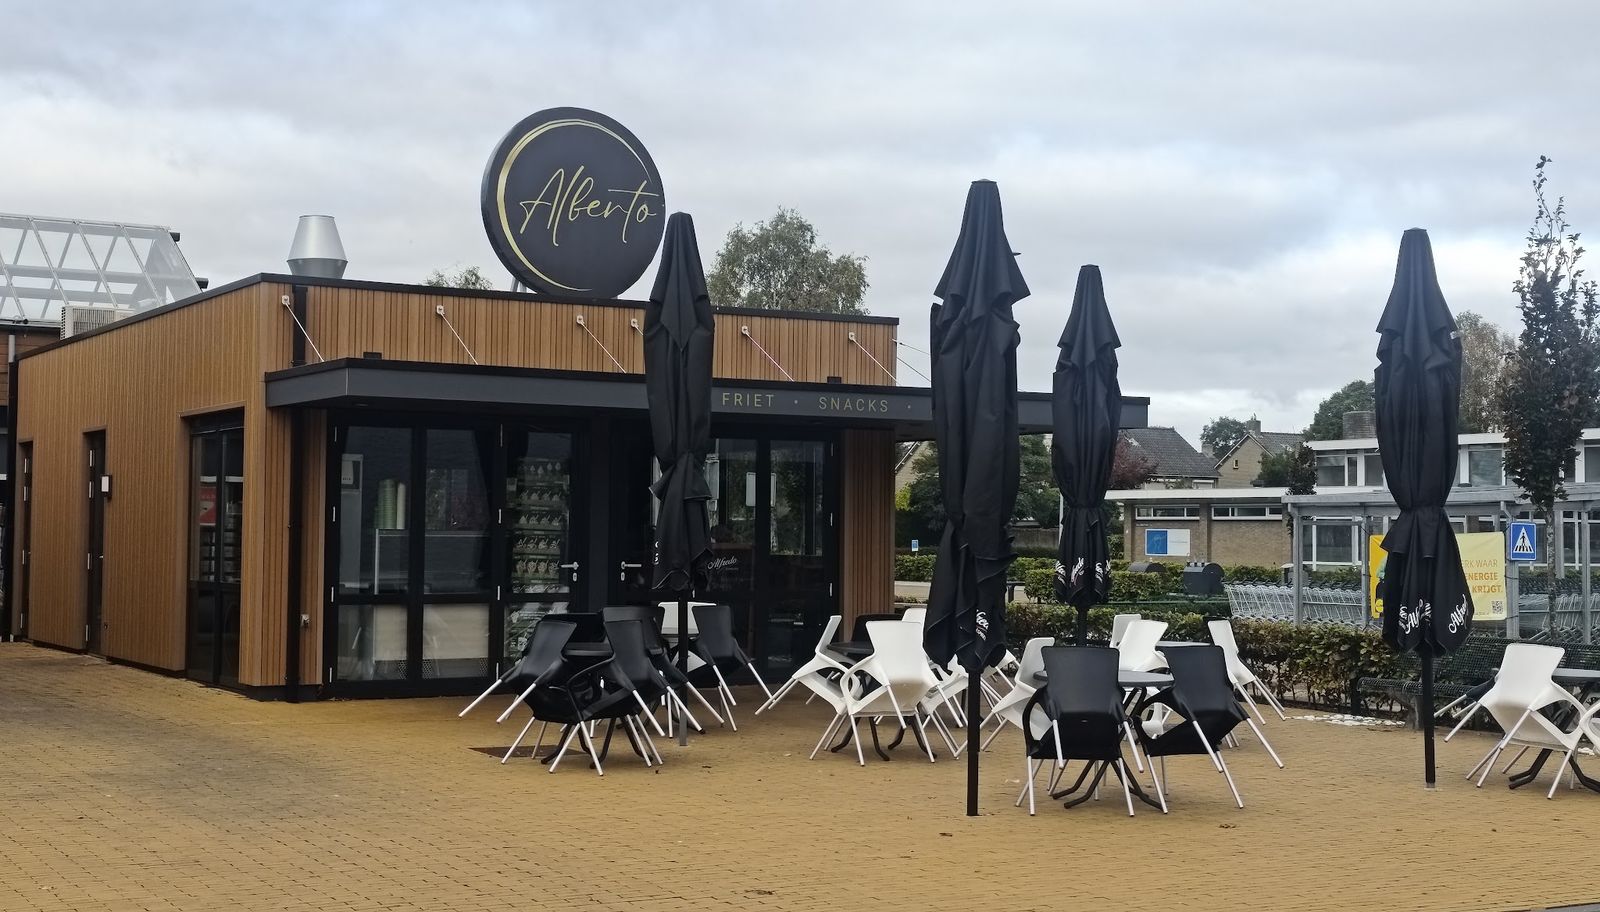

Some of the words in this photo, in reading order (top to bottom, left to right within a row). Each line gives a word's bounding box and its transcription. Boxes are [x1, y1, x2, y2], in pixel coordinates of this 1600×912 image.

[519, 165, 660, 247] Alberto
[722, 392, 775, 408] FRIET
[818, 396, 889, 413] SNACKS
[1475, 559, 1498, 568] WAAR
